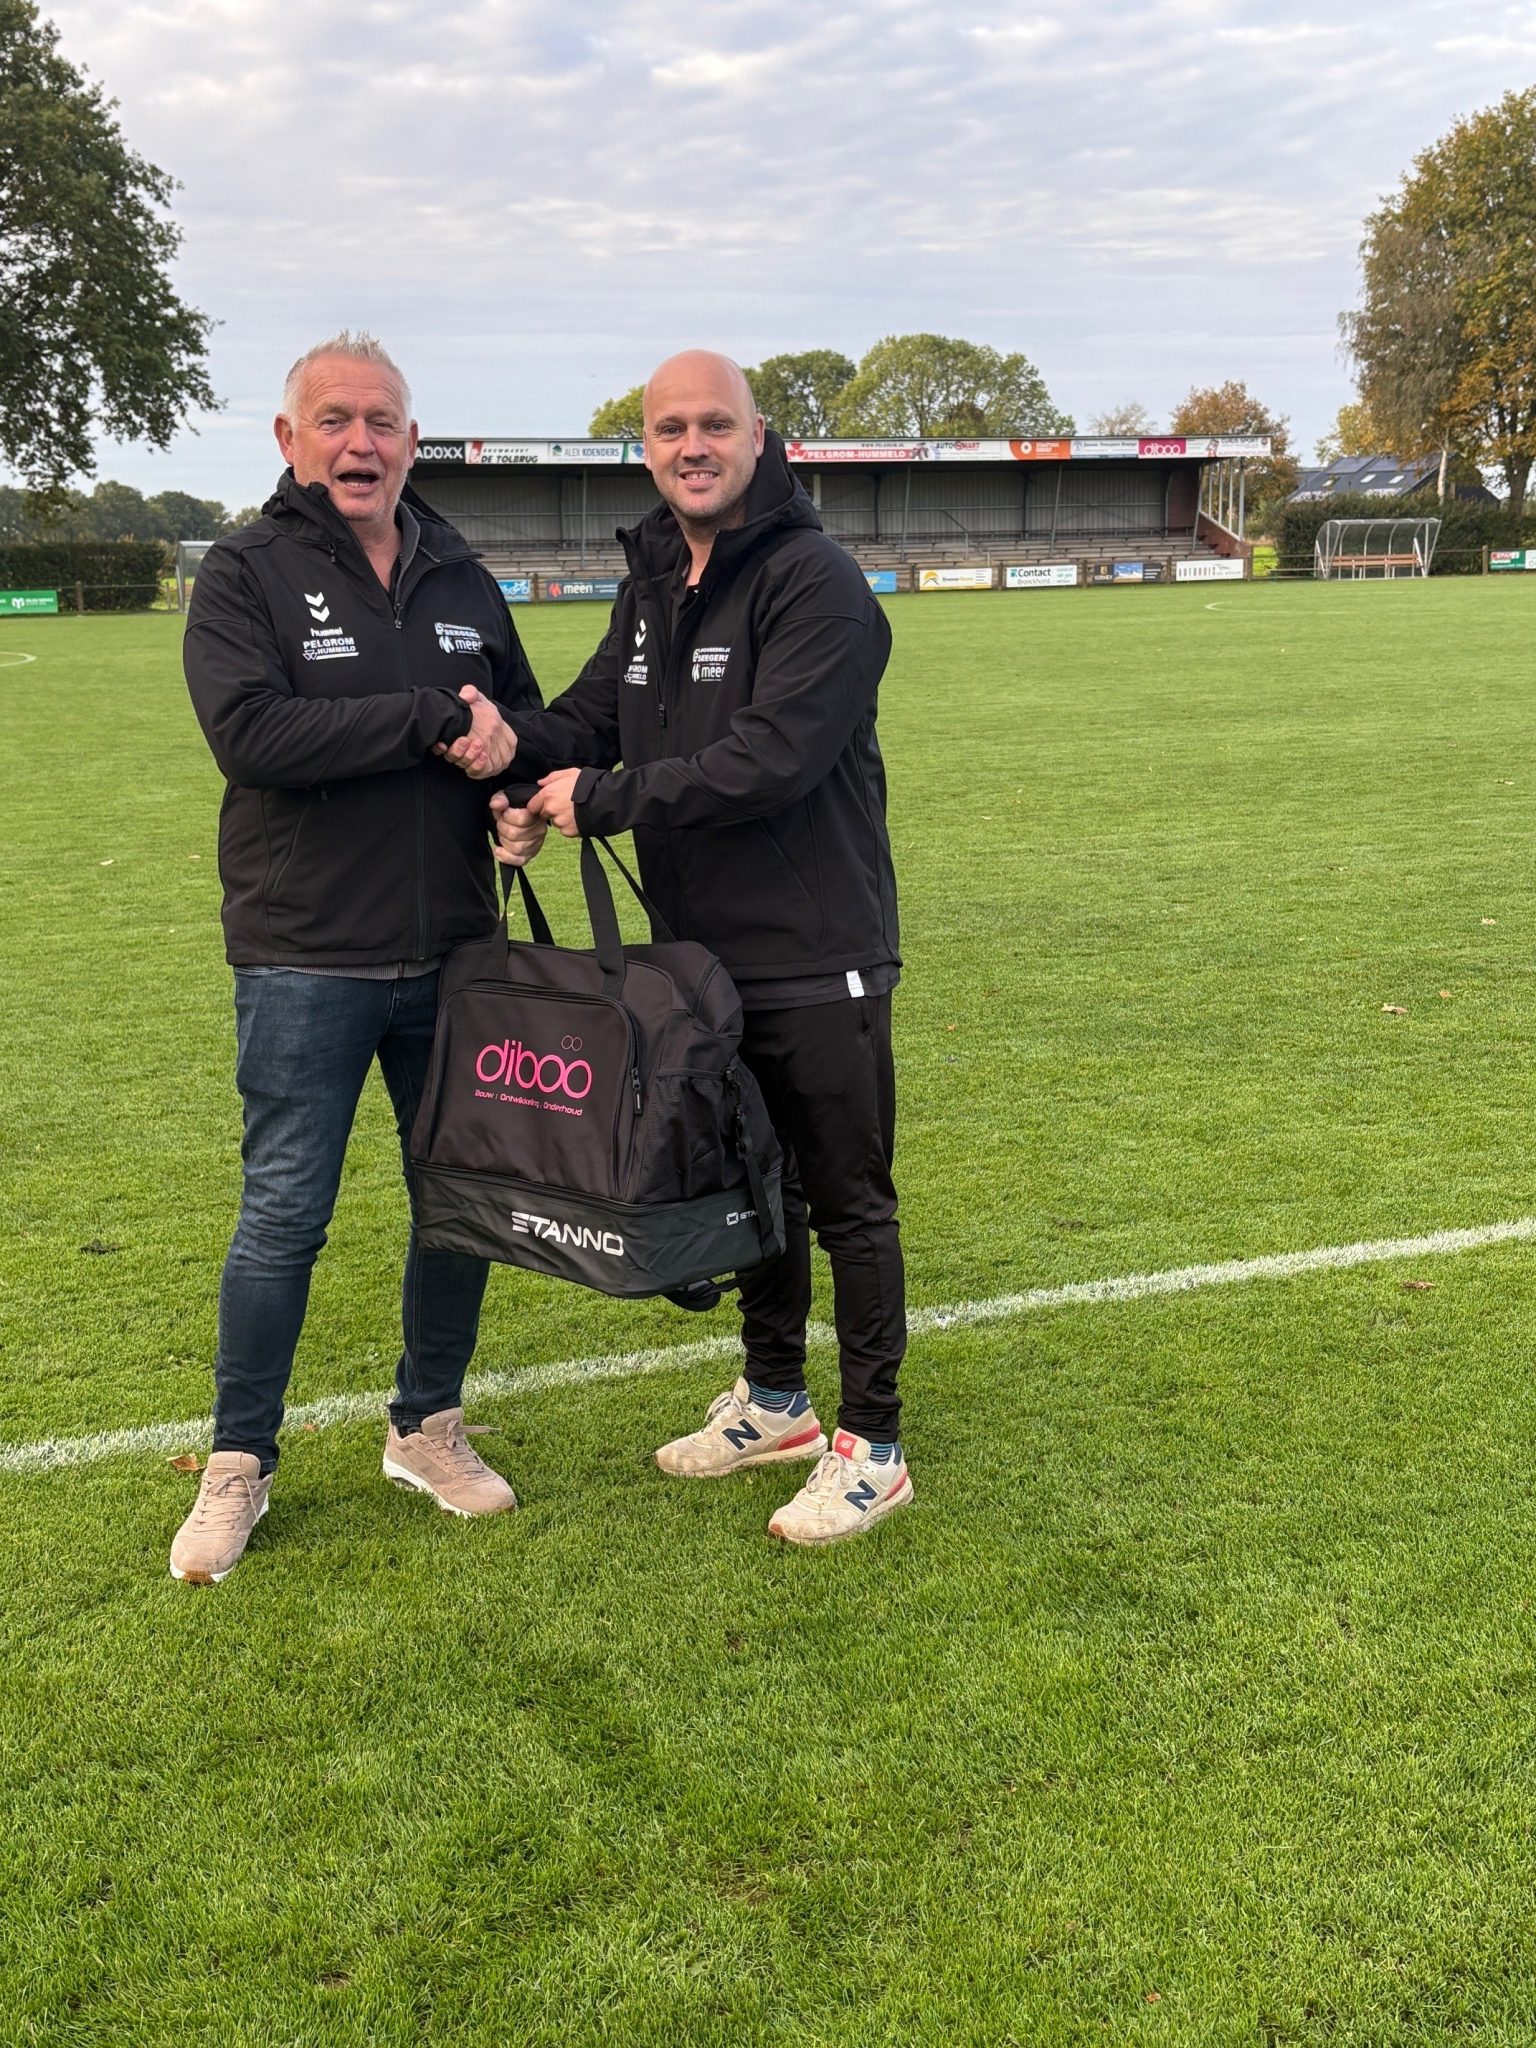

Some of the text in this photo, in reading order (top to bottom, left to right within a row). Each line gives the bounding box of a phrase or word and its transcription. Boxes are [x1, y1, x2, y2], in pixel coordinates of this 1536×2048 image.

[564, 447, 620, 457] ALEX KOENDERS
[481, 455, 538, 463] DE TOLBRUG
[1018, 568, 1051, 578] Contact
[303, 637, 355, 650] PELGROM
[317, 646, 356, 654] HUMMELO
[475, 1089, 583, 1116] Bouw Ontwikkeling Onderhoud
[511, 1211, 624, 1257] STANNO
